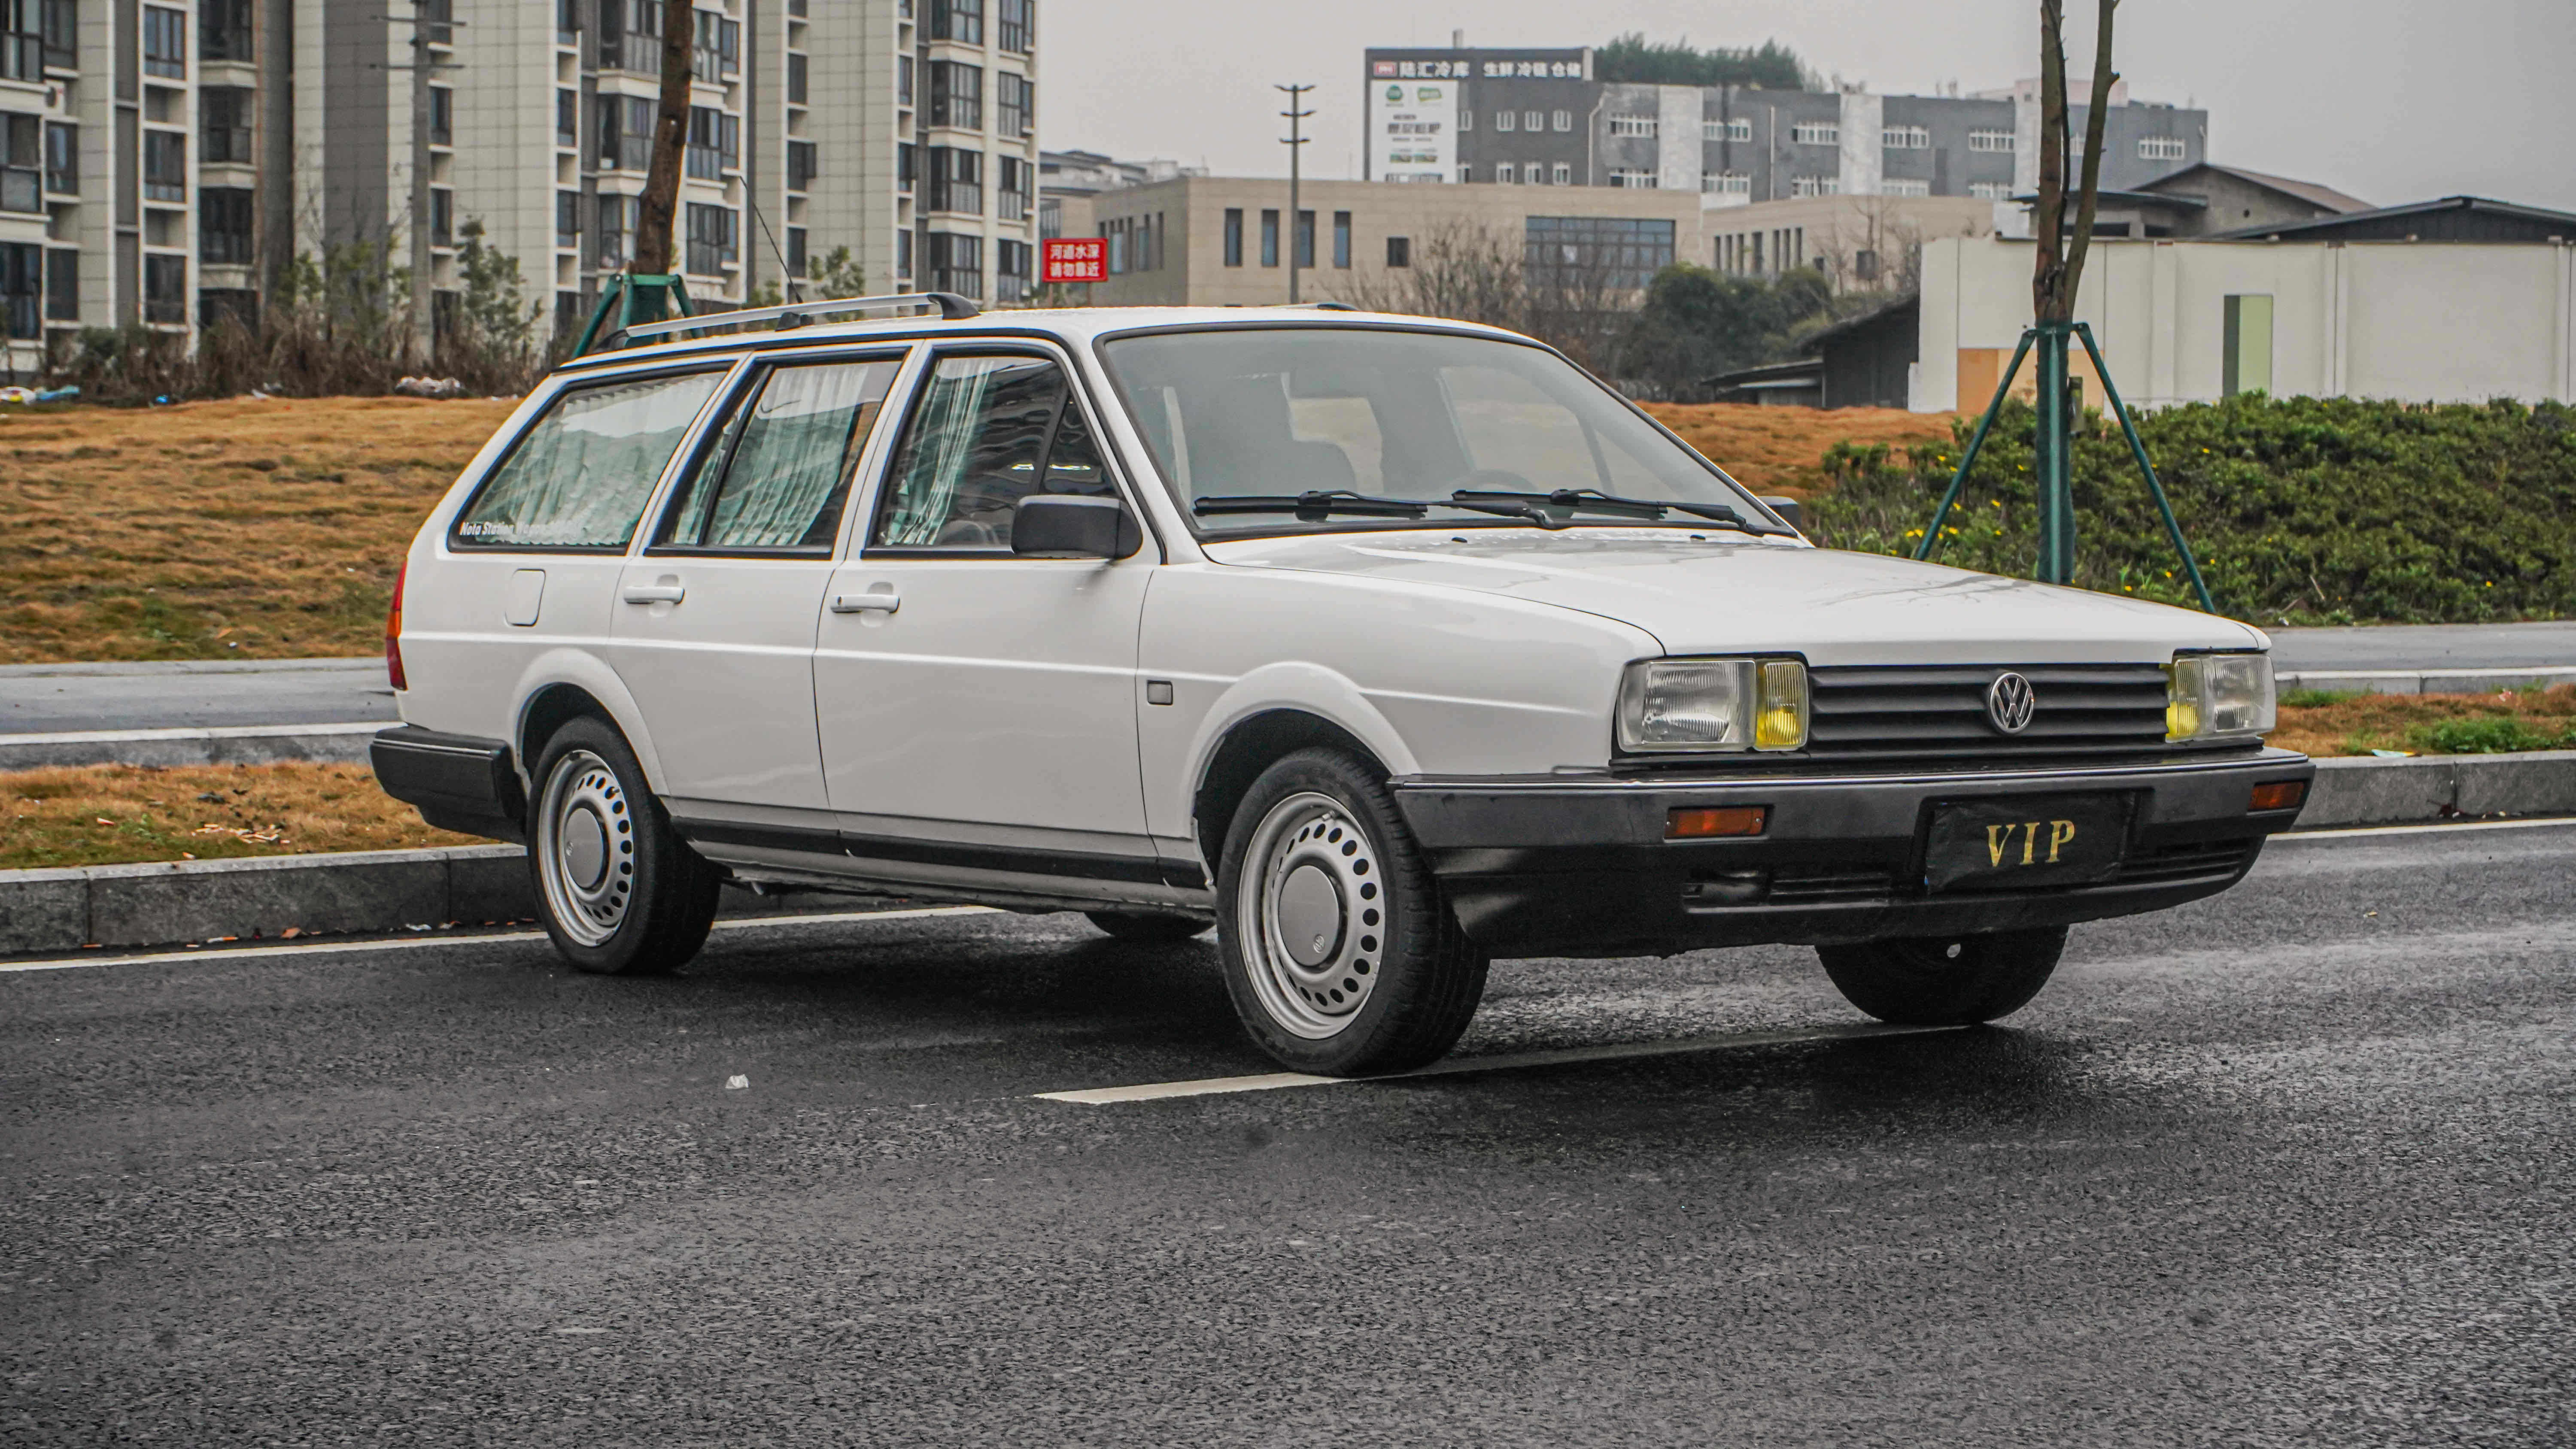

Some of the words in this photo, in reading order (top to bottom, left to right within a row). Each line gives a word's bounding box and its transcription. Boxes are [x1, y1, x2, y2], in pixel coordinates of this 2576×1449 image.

[1050, 244, 1100, 260] 河道水深
[1050, 261, 1100, 277] 请勿靠近
[1990, 673, 2034, 731] VW
[1986, 820, 2075, 867] VIP
